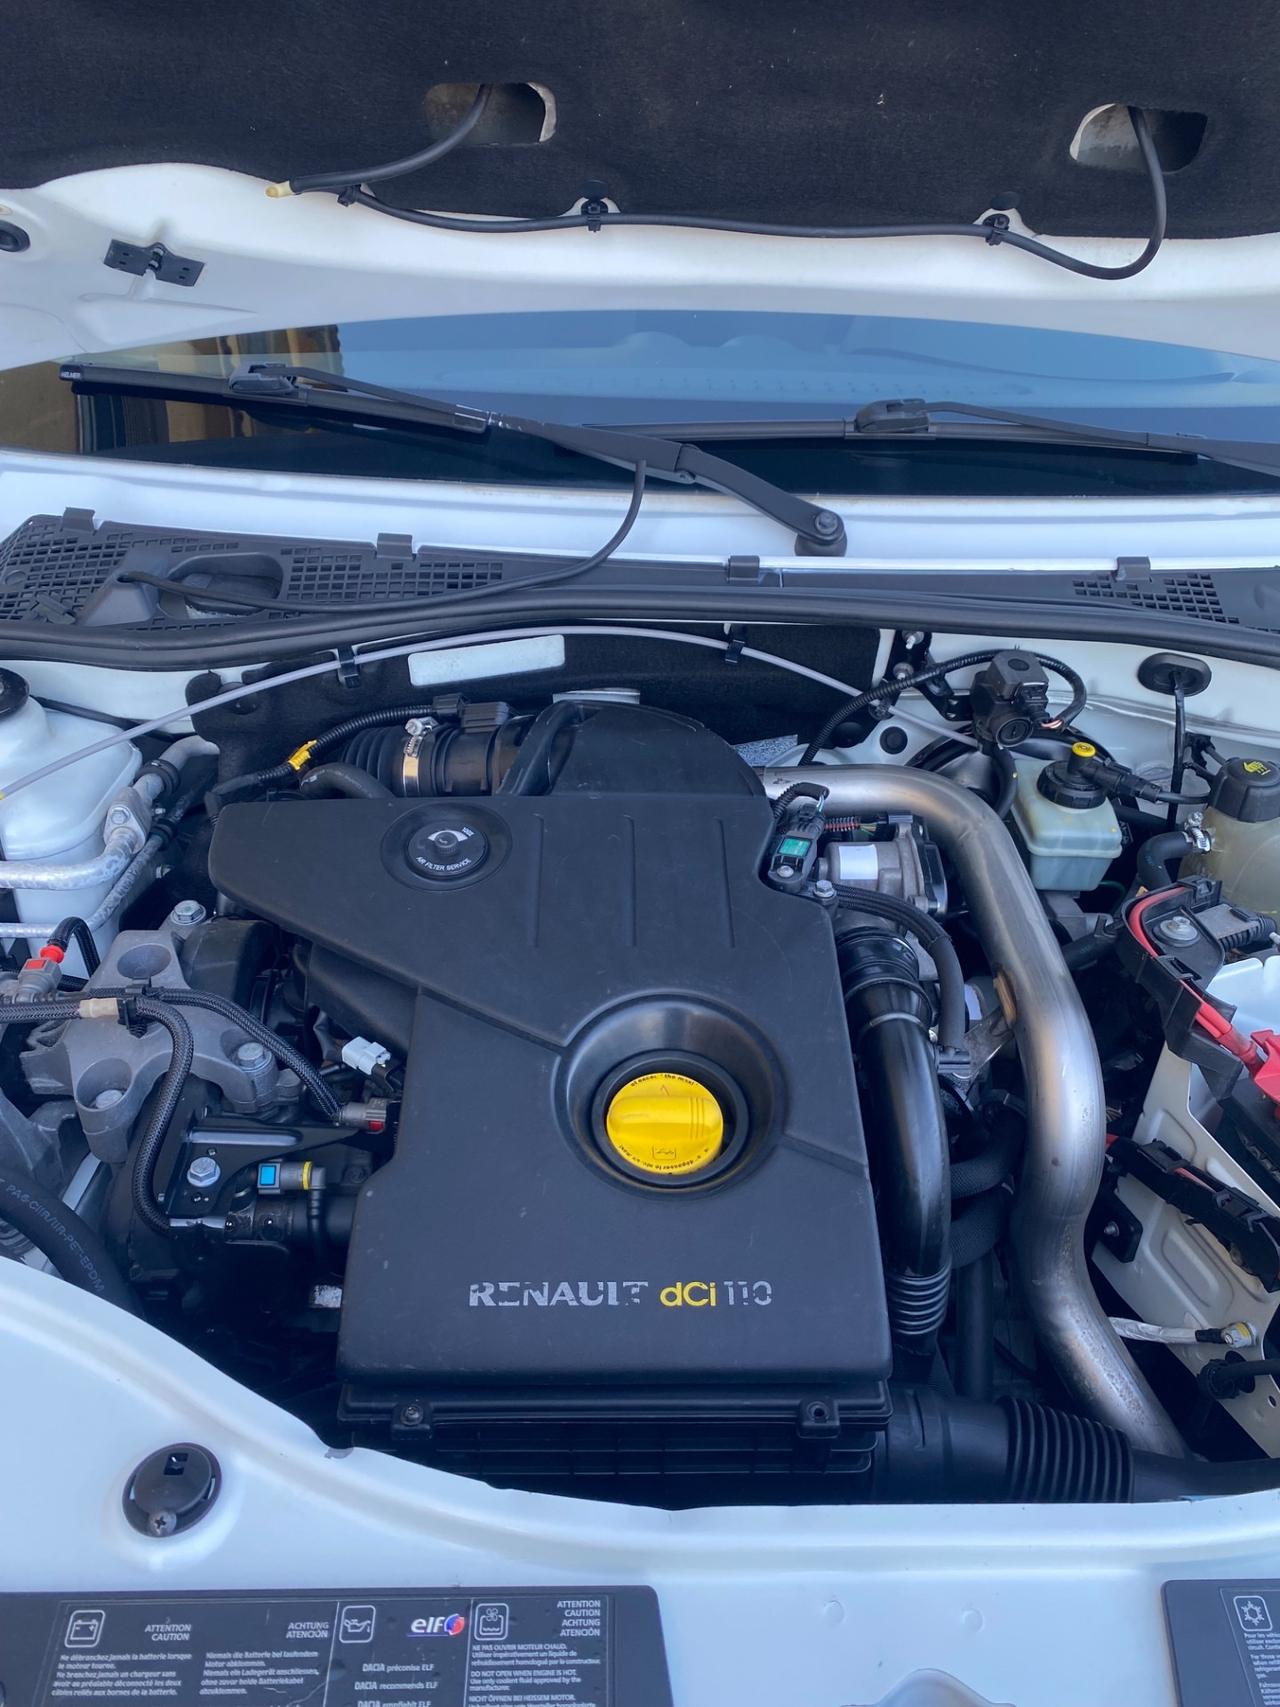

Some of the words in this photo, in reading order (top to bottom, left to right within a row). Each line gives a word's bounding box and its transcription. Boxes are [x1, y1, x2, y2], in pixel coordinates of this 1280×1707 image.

[425, 861, 445, 871] FILTER
[469, 1281, 649, 1307] RENAULT
[660, 1281, 716, 1307] dCi
[723, 1280, 773, 1306] 110
[557, 1600, 601, 1609] ATTENTION
[564, 1609, 601, 1618] CAUTION
[288, 1622, 329, 1630] ACHTUNG
[411, 1615, 445, 1634] elf
[562, 1618, 601, 1628] ACHTUNG
[144, 1624, 192, 1633] ATTENTION
[560, 1627, 601, 1637] ATENCIÓN
[151, 1633, 190, 1642] CAUTION
[286, 1629, 329, 1639] ATENCIÓN
[362, 1663, 385, 1672] DACIA
[421, 1663, 435, 1671] ELF
[354, 1681, 378, 1690] DACIA
[425, 1681, 438, 1689] ELF
